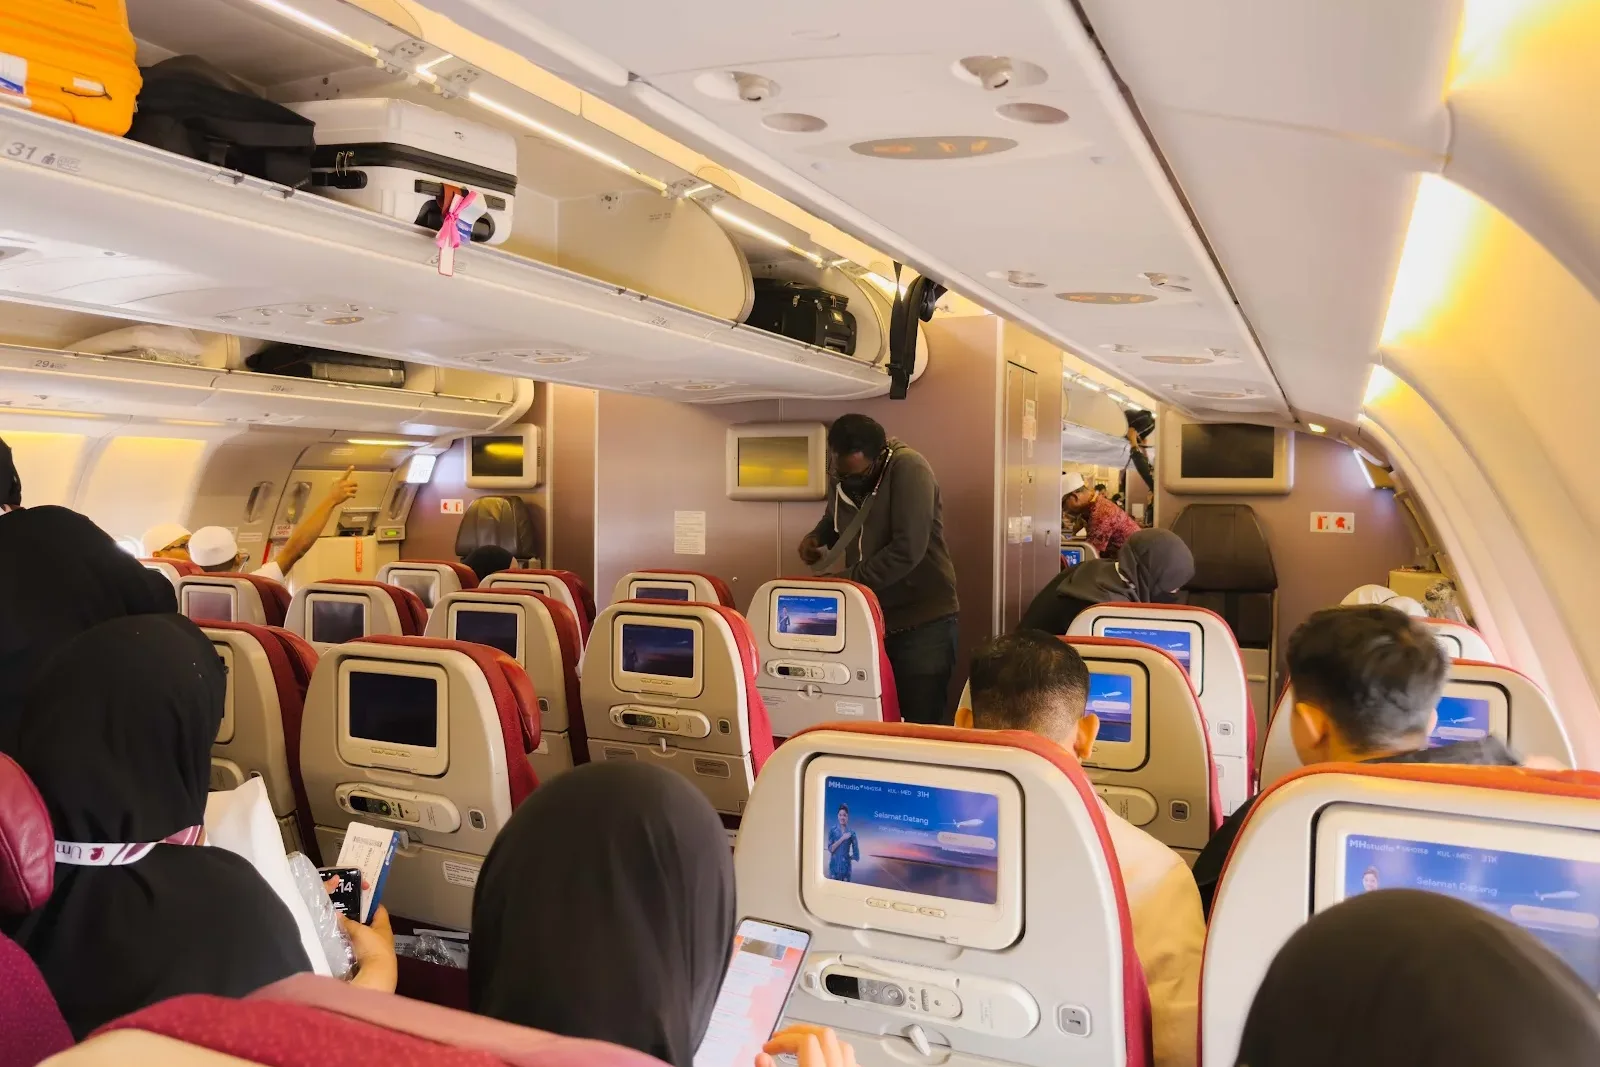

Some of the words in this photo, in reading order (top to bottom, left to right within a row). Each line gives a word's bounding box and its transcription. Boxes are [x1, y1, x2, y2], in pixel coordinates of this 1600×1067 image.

[7, 142, 38, 160] 31
[34, 359, 50, 368] 29
[828, 780, 860, 791] MHstudio
[916, 790, 930, 799] 31H
[873, 811, 902, 821] Selamat
[902, 814, 929, 826] Datang
[1416, 876, 1457, 890] Selamat
